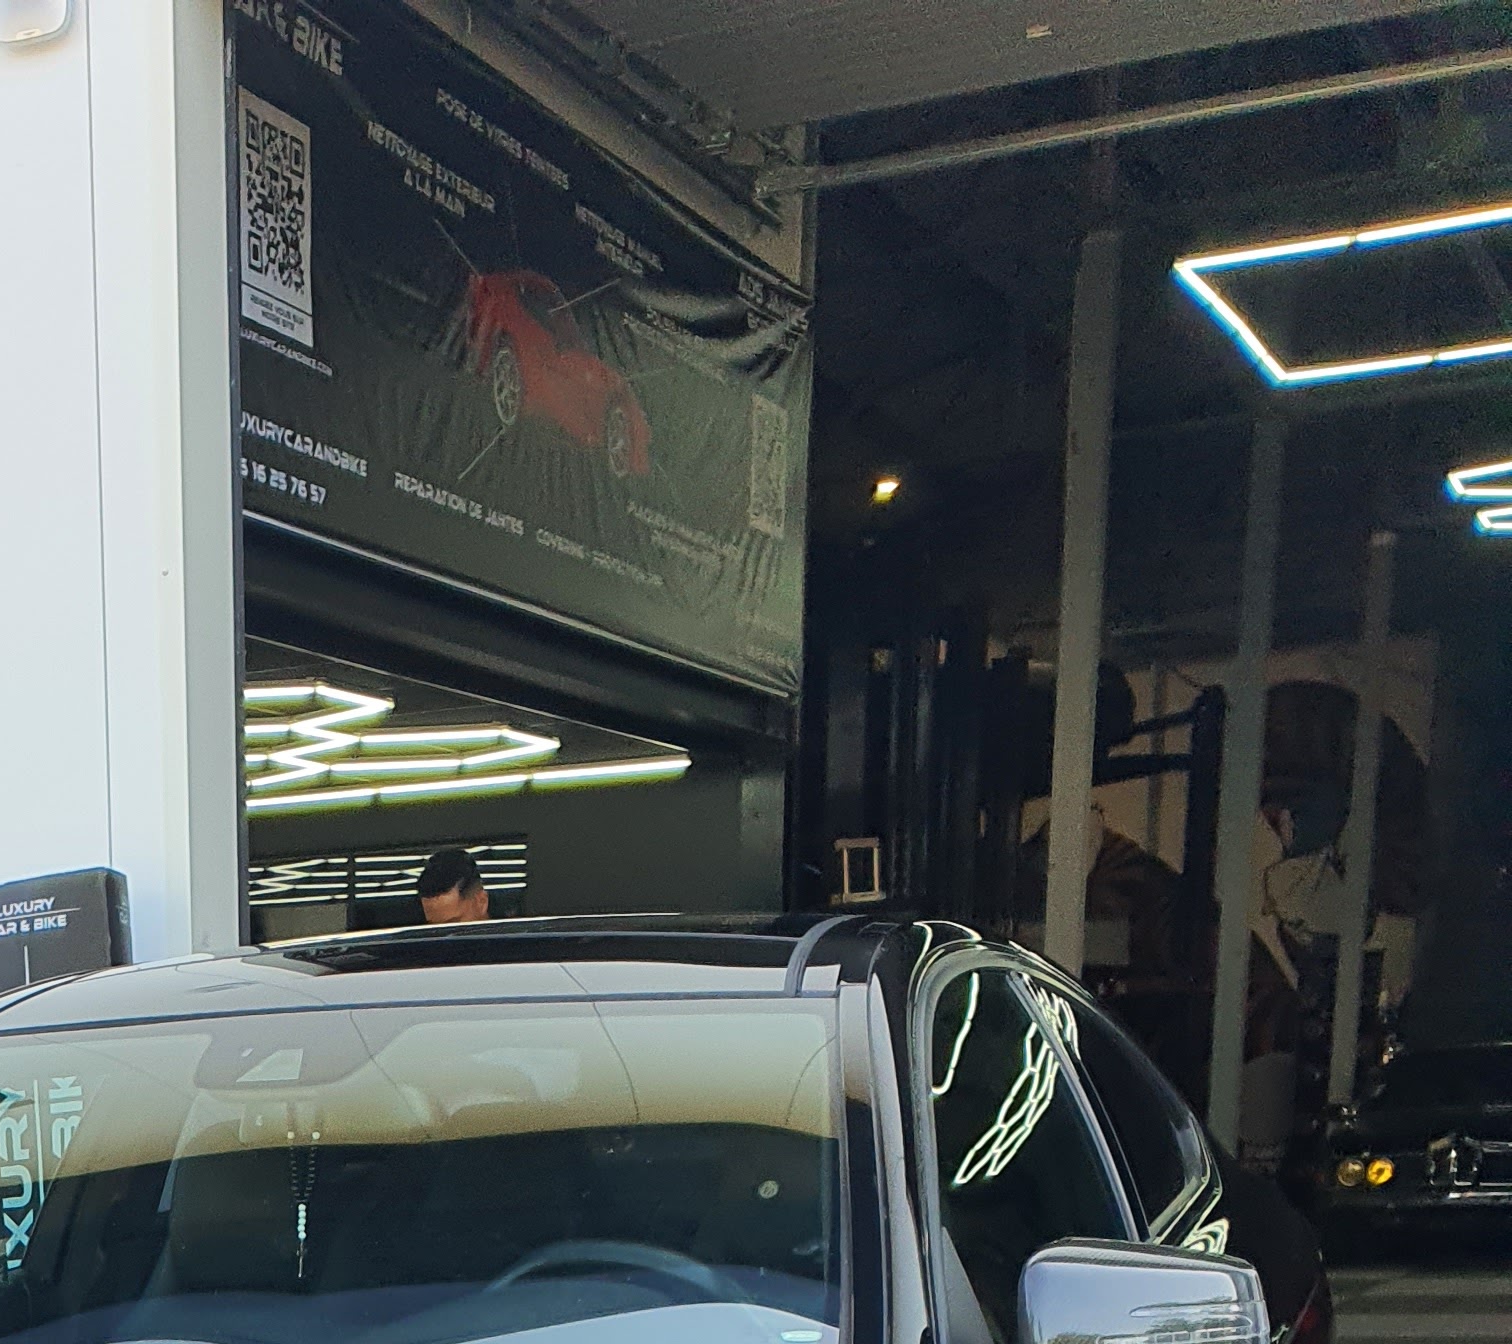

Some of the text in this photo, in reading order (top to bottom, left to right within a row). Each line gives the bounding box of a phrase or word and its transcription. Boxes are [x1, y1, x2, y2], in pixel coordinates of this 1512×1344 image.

[292, 15, 343, 76] BIKE
[290, 475, 308, 499] 76
[310, 483, 326, 505] 57
[20, 920, 31, 933] &
[34, 914, 68, 931] BIKE
